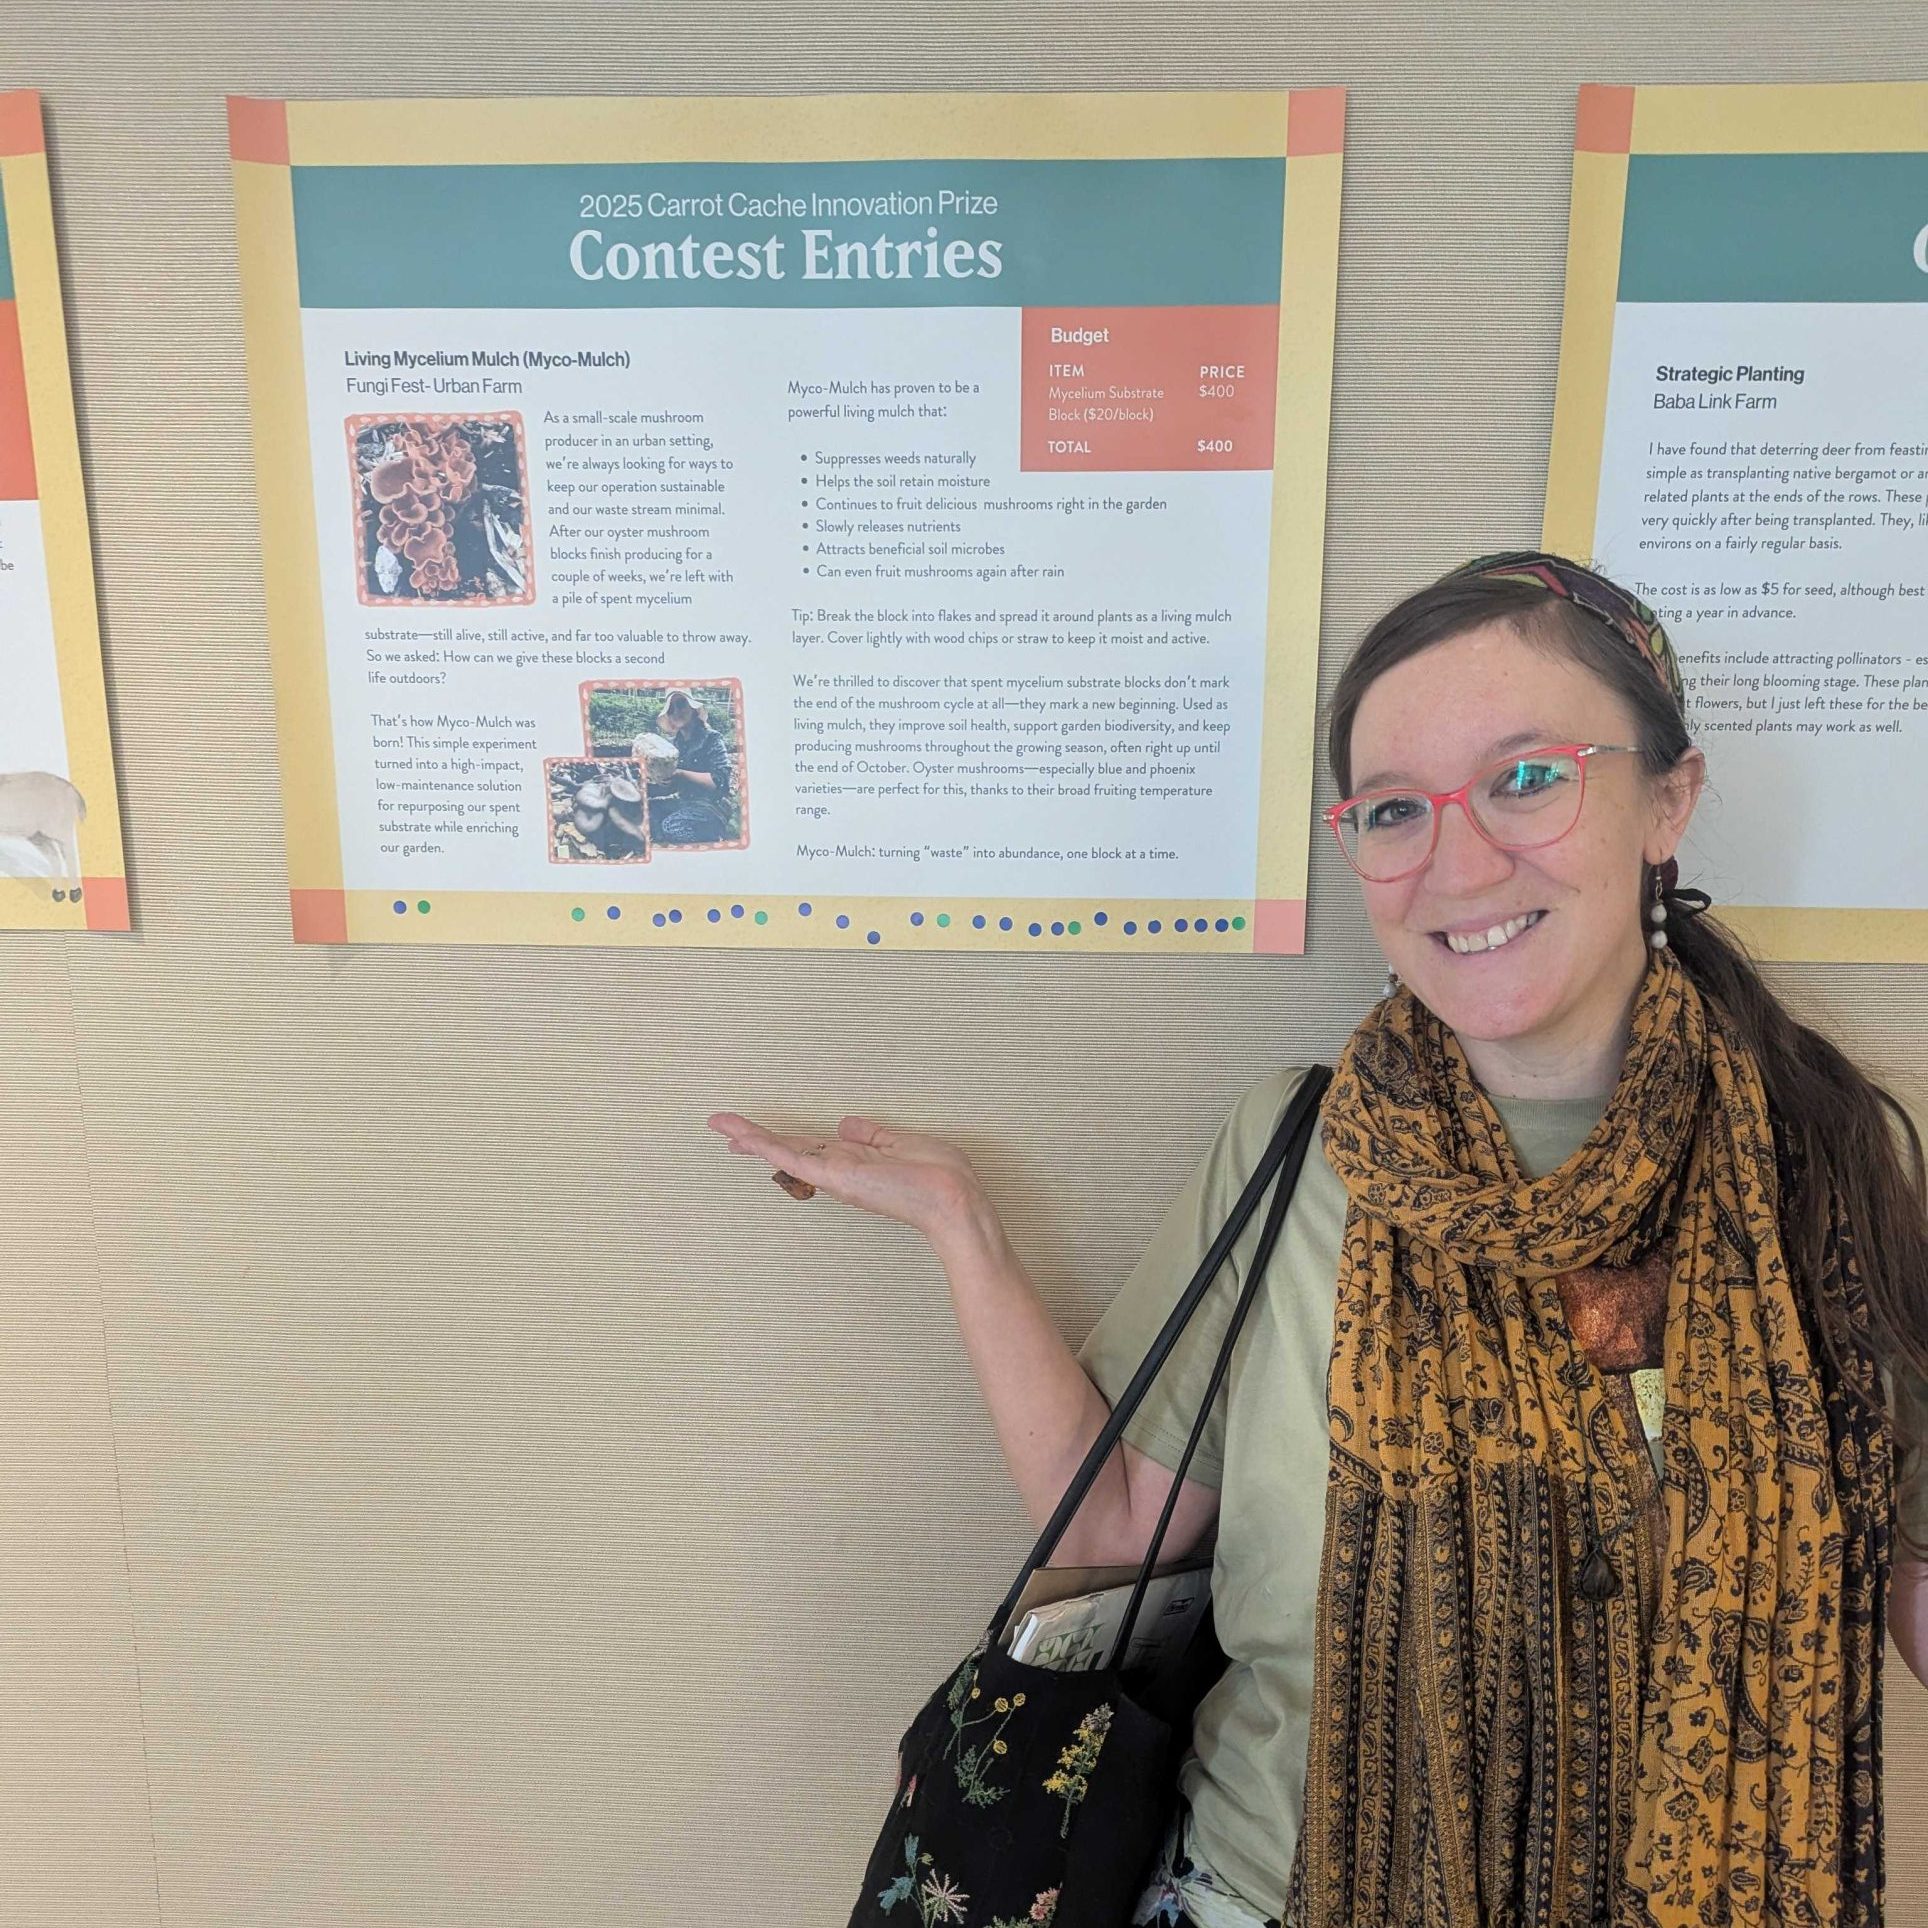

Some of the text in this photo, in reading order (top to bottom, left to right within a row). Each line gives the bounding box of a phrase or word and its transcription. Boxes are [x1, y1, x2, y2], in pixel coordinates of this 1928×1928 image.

[580, 190, 998, 218] 2025 Carrot Cache Innovation Prize
[570, 226, 1003, 281] Contest Entries
[1051, 327, 1110, 346] Budget
[345, 350, 630, 370] Living Mycelium Mulch (Myco-Mulch)
[1050, 364, 1084, 377] ITEM
[1200, 365, 1245, 379] PRICE
[1656, 365, 1805, 385] Strategic Planting
[347, 377, 523, 396] Fungi Fest- Urban Farm
[787, 380, 980, 398] Myco-Mulch has proven to be a
[1049, 385, 1164, 403] Mycelium Substrate
[1199, 384, 1234, 398] $400
[1654, 393, 1777, 410] Baba Link Farm
[543, 410, 704, 424] As a small-scale mushroom
[788, 404, 947, 422] powerful living mulch that:
[1049, 407, 1154, 423] Block ($20/block)
[545, 433, 714, 451] producer in an urban setting,
[1048, 440, 1092, 453] TOTAL
[1197, 439, 1233, 453] $400
[815, 451, 977, 468] Suppresses weeds naturally
[816, 474, 991, 491] Helps the soil retain moisture
[1646, 465, 1915, 484] simple as transplanting native bergamot or
[548, 502, 725, 515] and our waste stream minimal.
[549, 524, 710, 542] After our oyster mushroom
[816, 519, 961, 536] Slowly releases nutrients
[816, 542, 1006, 555] Attracts beneficial soil microbes
[1639, 535, 1842, 554] environs on a fairly regular basis.
[550, 547, 713, 564] blocks finish producing for a
[1686, 605, 1796, 623] a year in advance.
[792, 630, 1210, 649] layer. Cover lightly with wood chips or straw to keep it moist and active.
[367, 649, 665, 667] So we asked: How can we give these blocks a second
[372, 714, 536, 732] That's how Myco-Mulch was
[1704, 718, 1753, 732] scented
[1755, 719, 1793, 736] plants
[1796, 723, 1823, 737] may
[1826, 720, 1856, 732] work
[1859, 724, 1872, 733] as
[1875, 720, 1902, 733] well.
[373, 736, 537, 753] born! This simple experiment
[795, 739, 1221, 757] producing mushrooms throughout the growing season, often right up until
[377, 799, 521, 817] for repurposing our spent
[796, 807, 831, 820] range.
[379, 820, 520, 837] substrate while enriching
